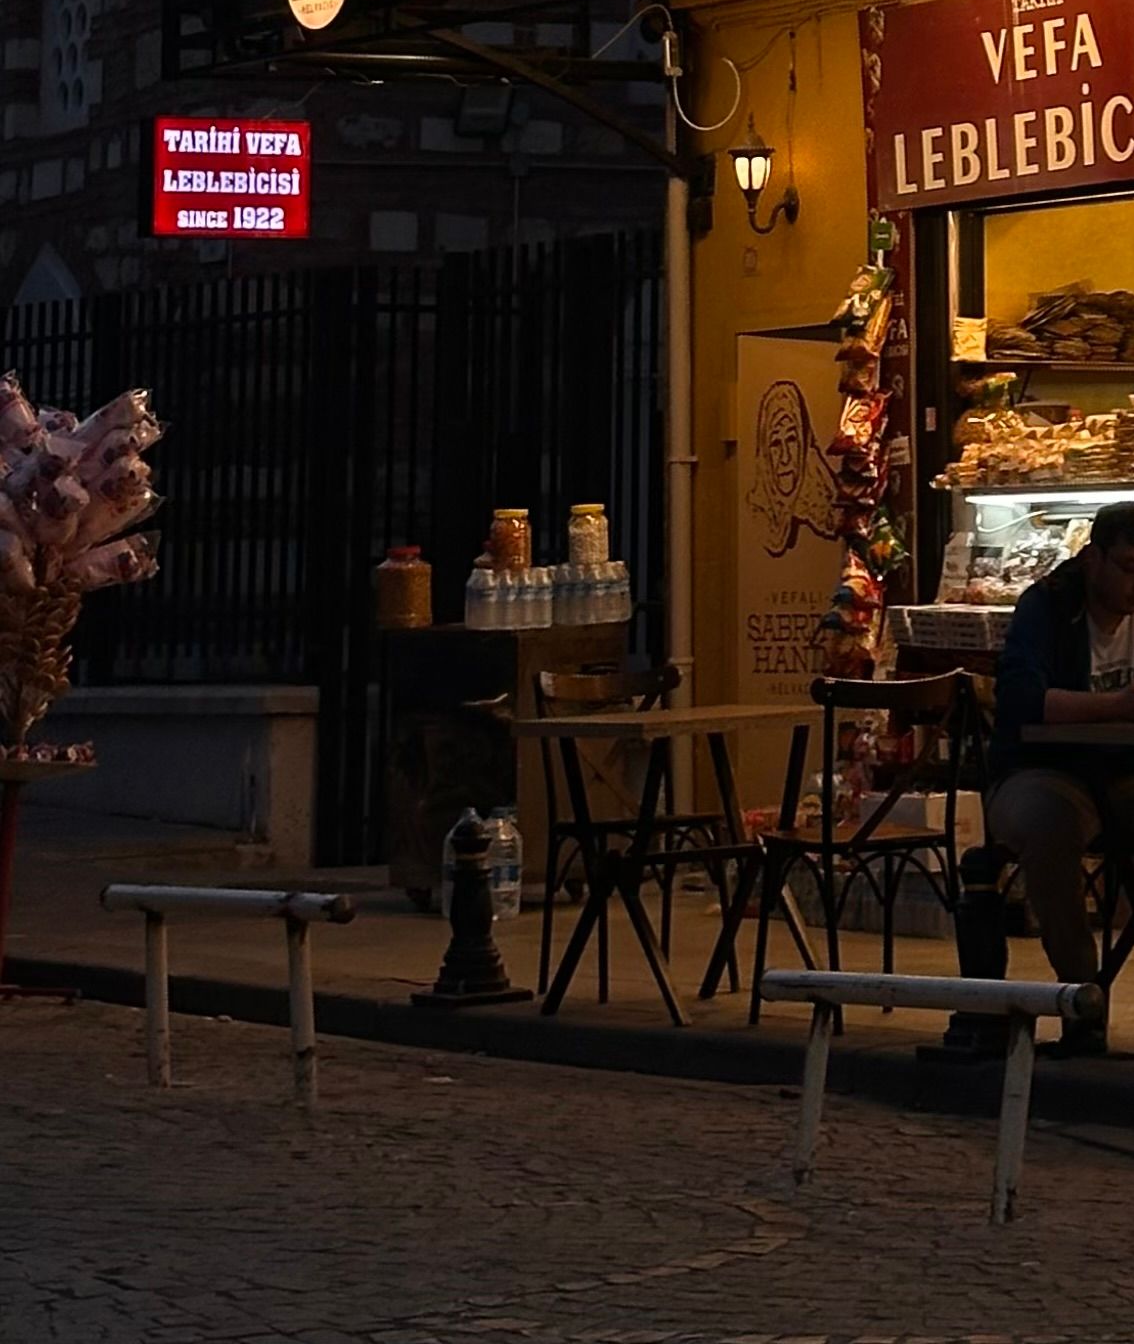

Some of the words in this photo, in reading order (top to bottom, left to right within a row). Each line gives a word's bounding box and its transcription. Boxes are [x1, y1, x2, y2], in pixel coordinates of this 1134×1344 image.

[980, 12, 1103, 86] VEFA
[163, 126, 241, 154] TARİHİ
[246, 132, 302, 156] VEFA
[162, 167, 301, 195] LEBLEBİCİSİ
[177, 210, 229, 229] SINCE
[233, 206, 285, 230] 1922
